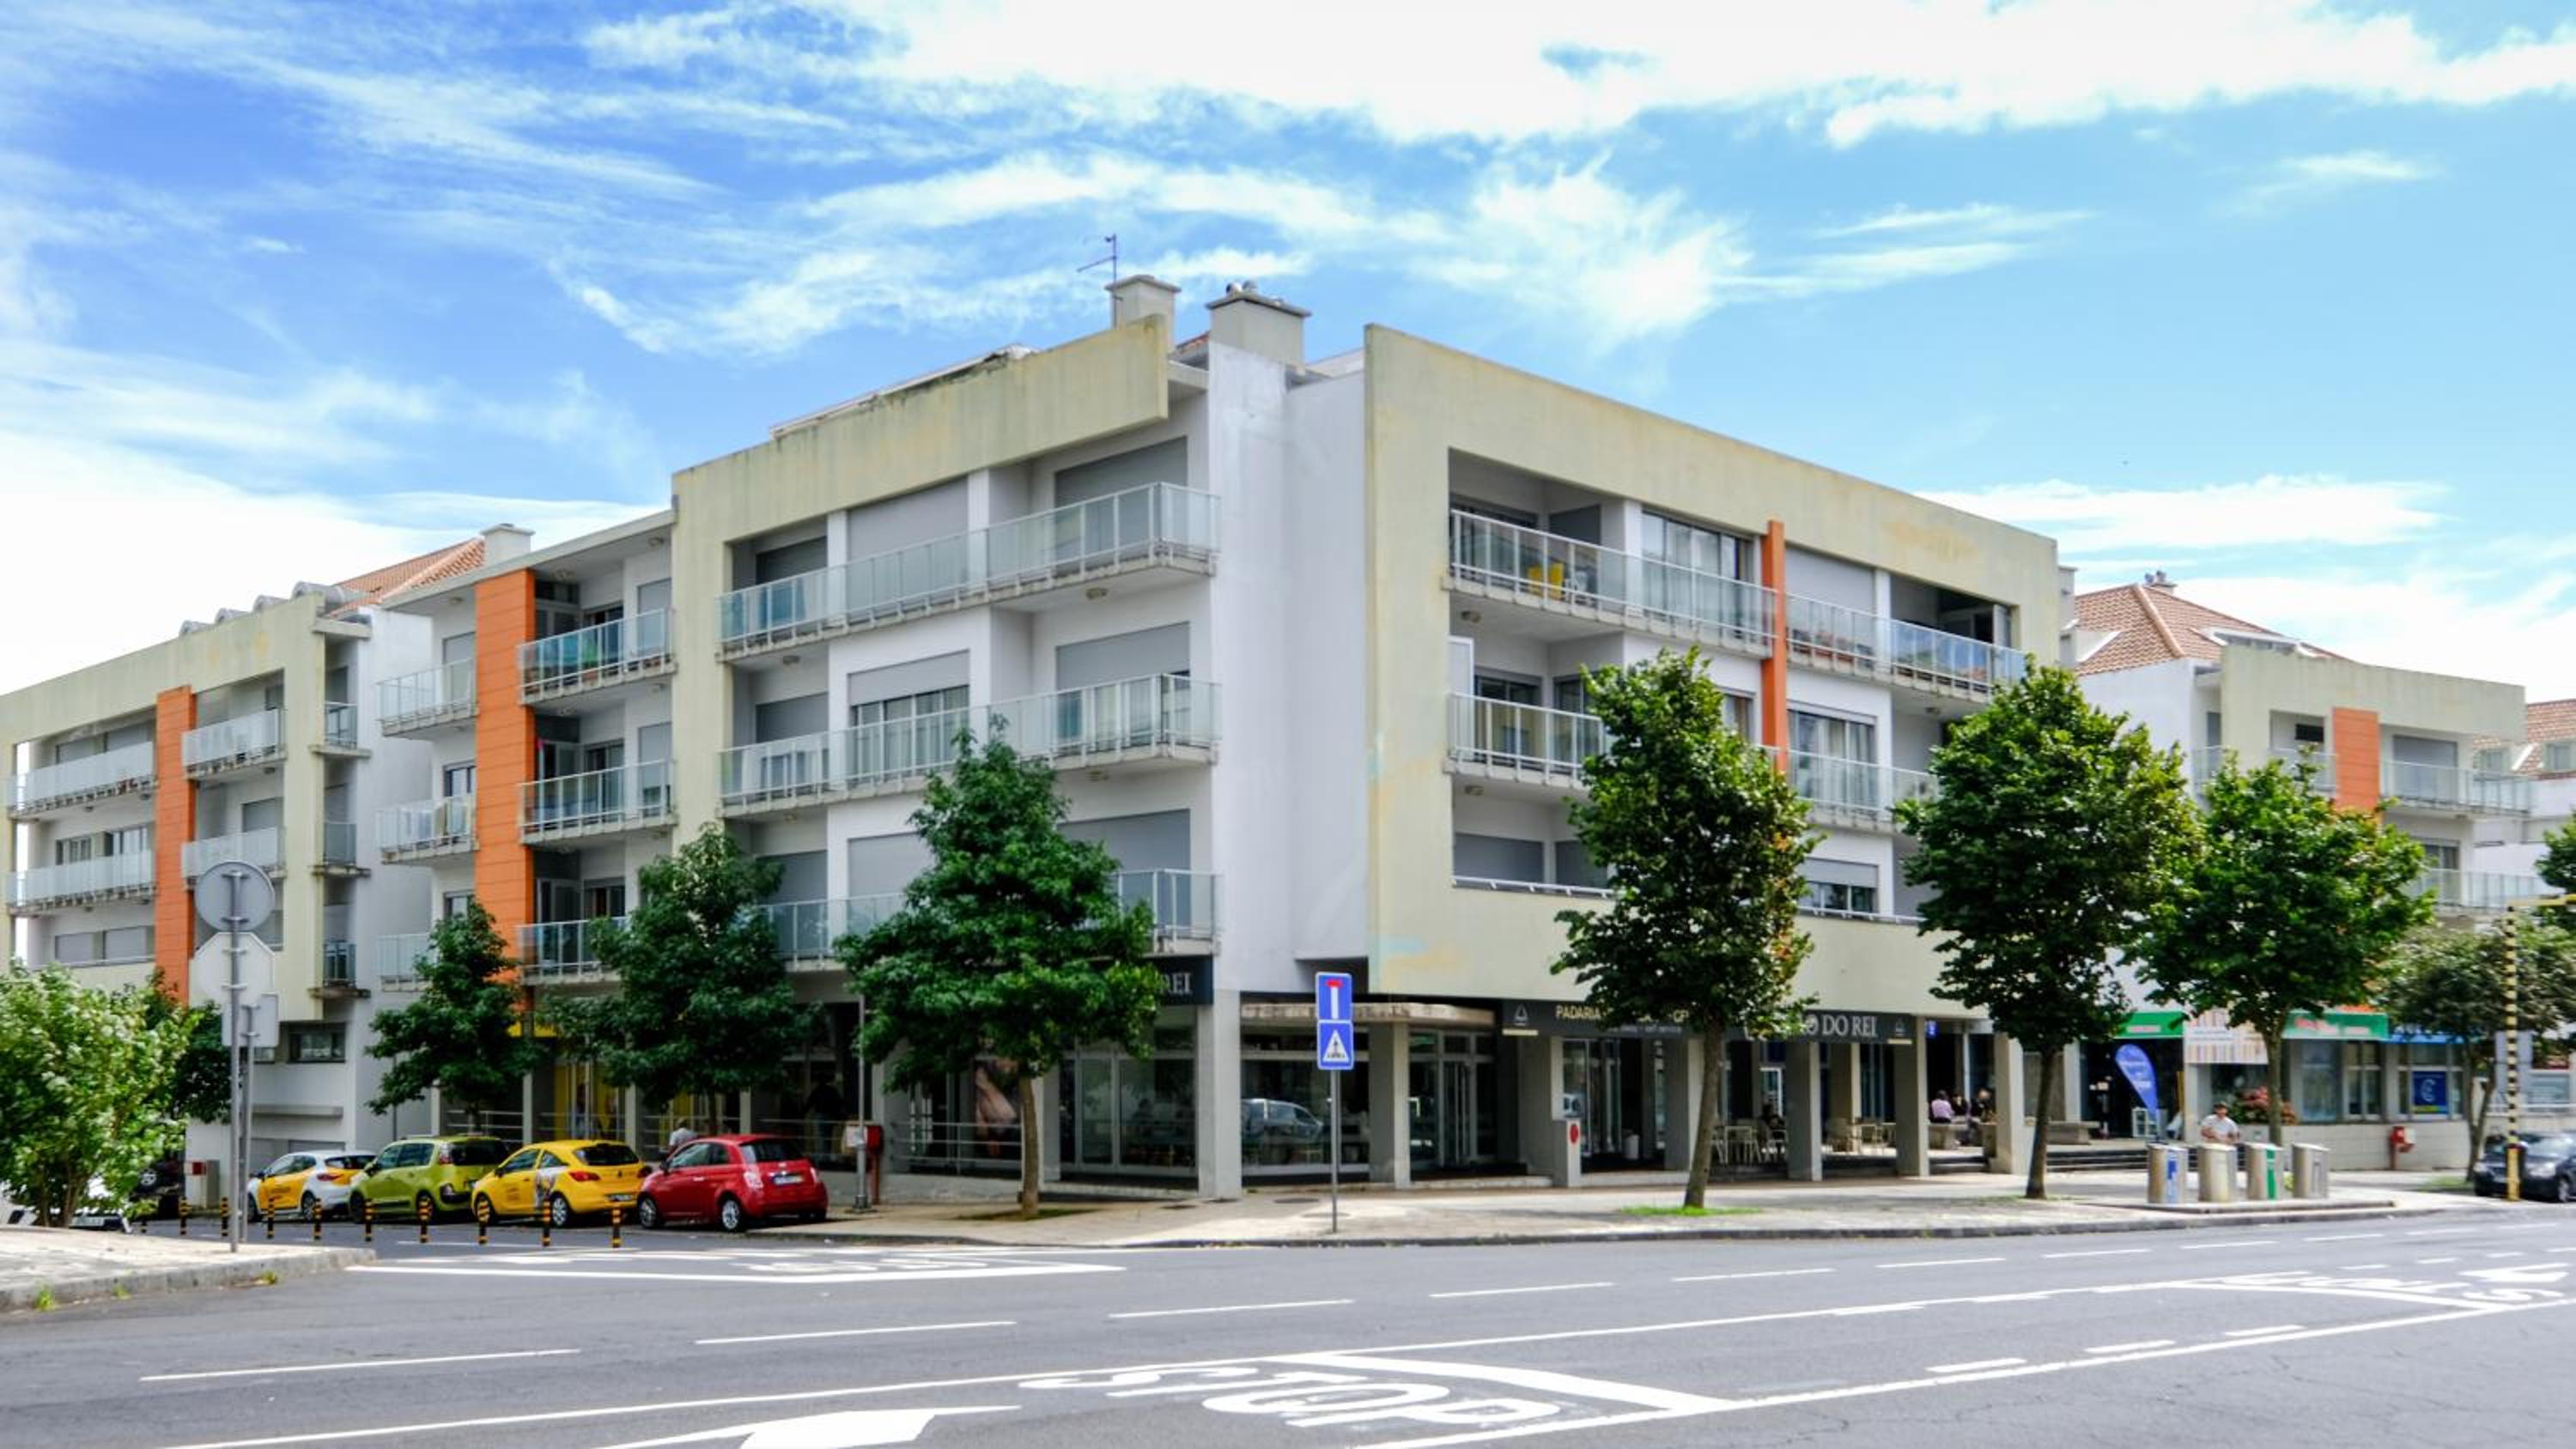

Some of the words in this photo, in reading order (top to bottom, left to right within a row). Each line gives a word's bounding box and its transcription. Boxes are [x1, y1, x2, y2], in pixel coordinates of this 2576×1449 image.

[1555, 1003, 1603, 1020] PADARIA
[1821, 1014, 1849, 1036] DO
[1851, 1015, 1878, 1038] REI
[1018, 1367, 1561, 1428] STOP
